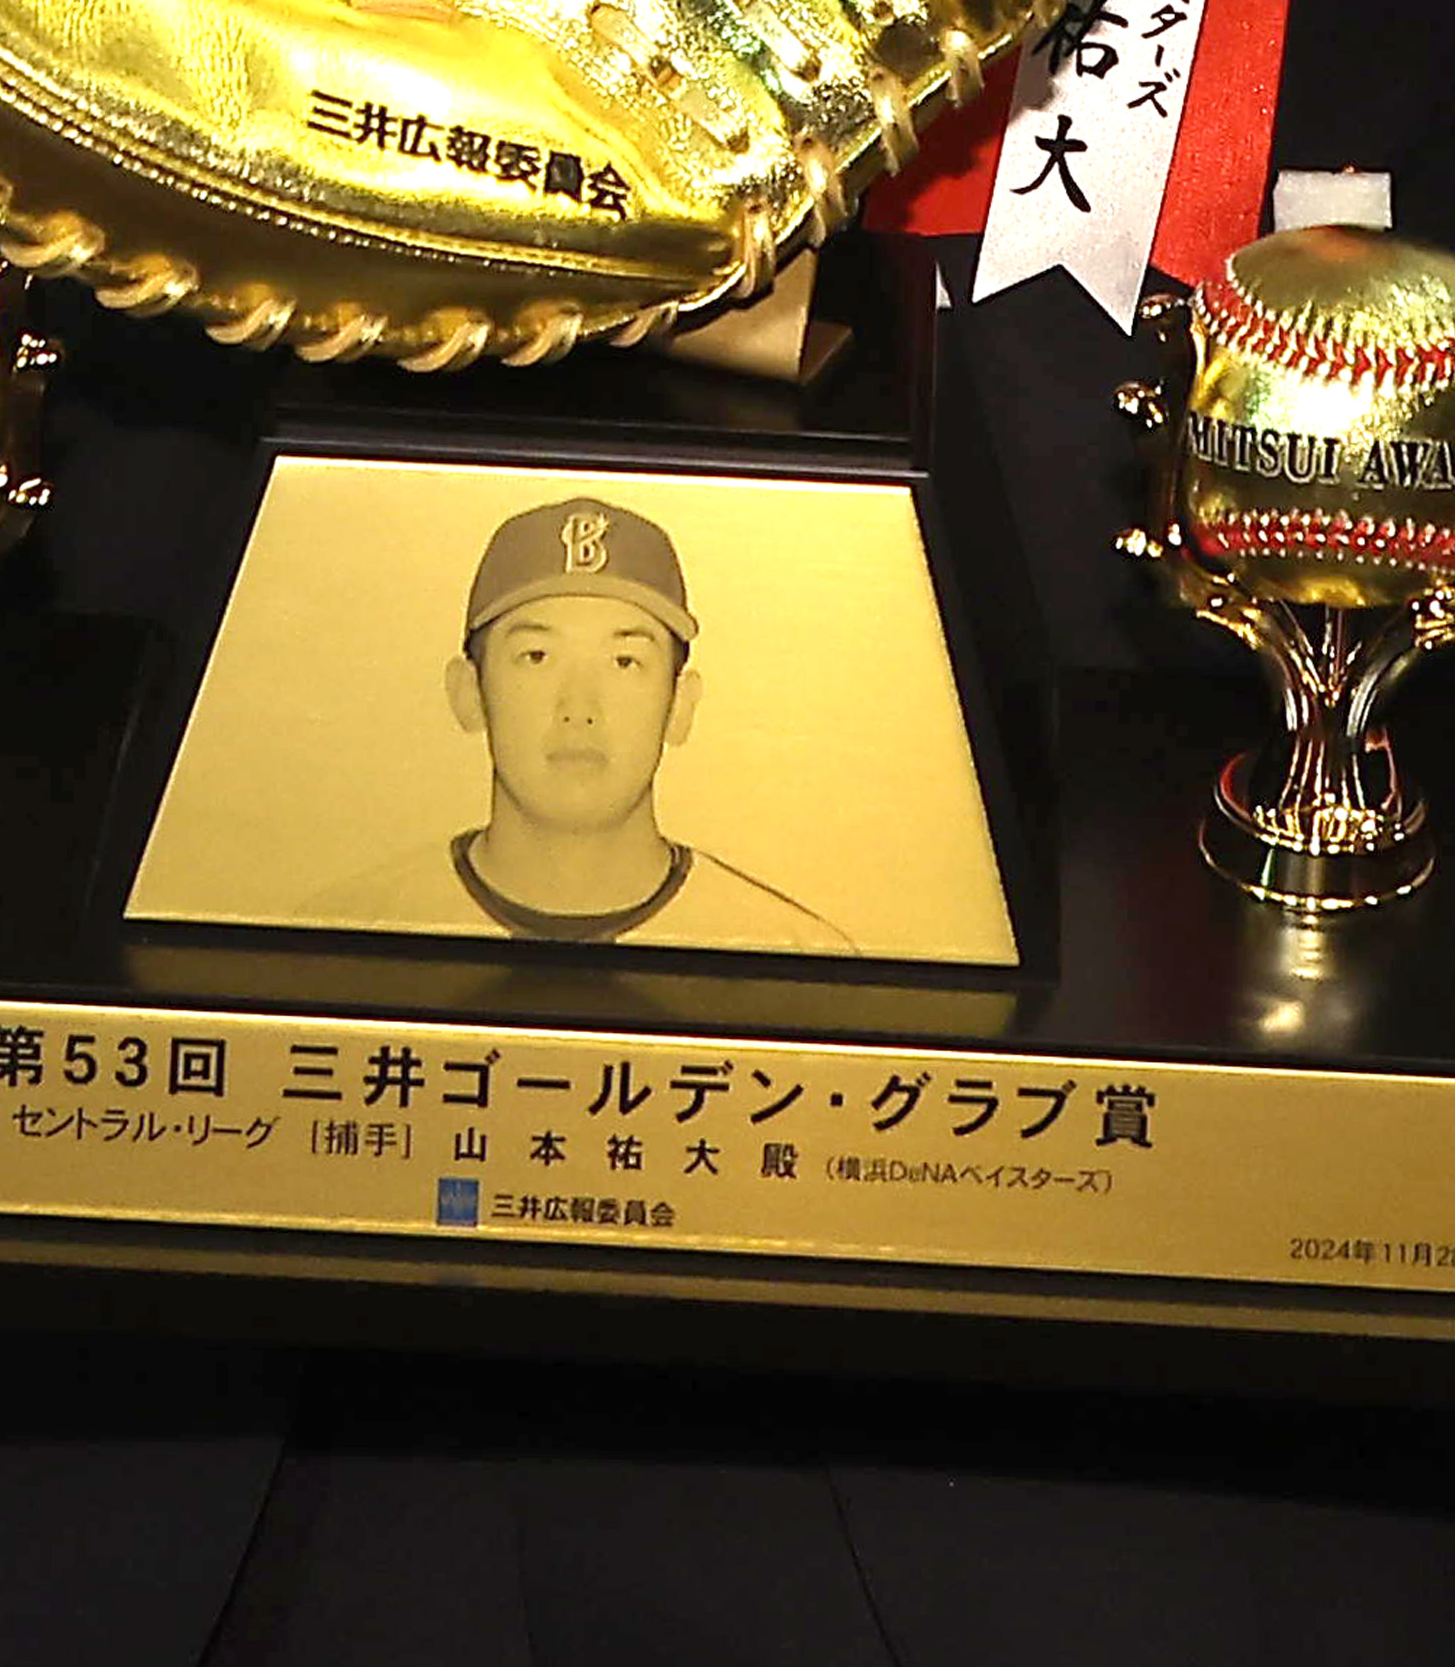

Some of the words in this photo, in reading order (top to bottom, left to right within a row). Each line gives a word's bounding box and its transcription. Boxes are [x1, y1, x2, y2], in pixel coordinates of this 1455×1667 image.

[306, 88, 632, 222] 三井広報委員会
[1185, 410, 1342, 485] MITSUI
[12, 1103, 281, 1149] セントラル・リーグ
[282, 1044, 1156, 1148] 三井ゴールデン・グラブ賞
[490, 1193, 676, 1228] 三井広報委員会
